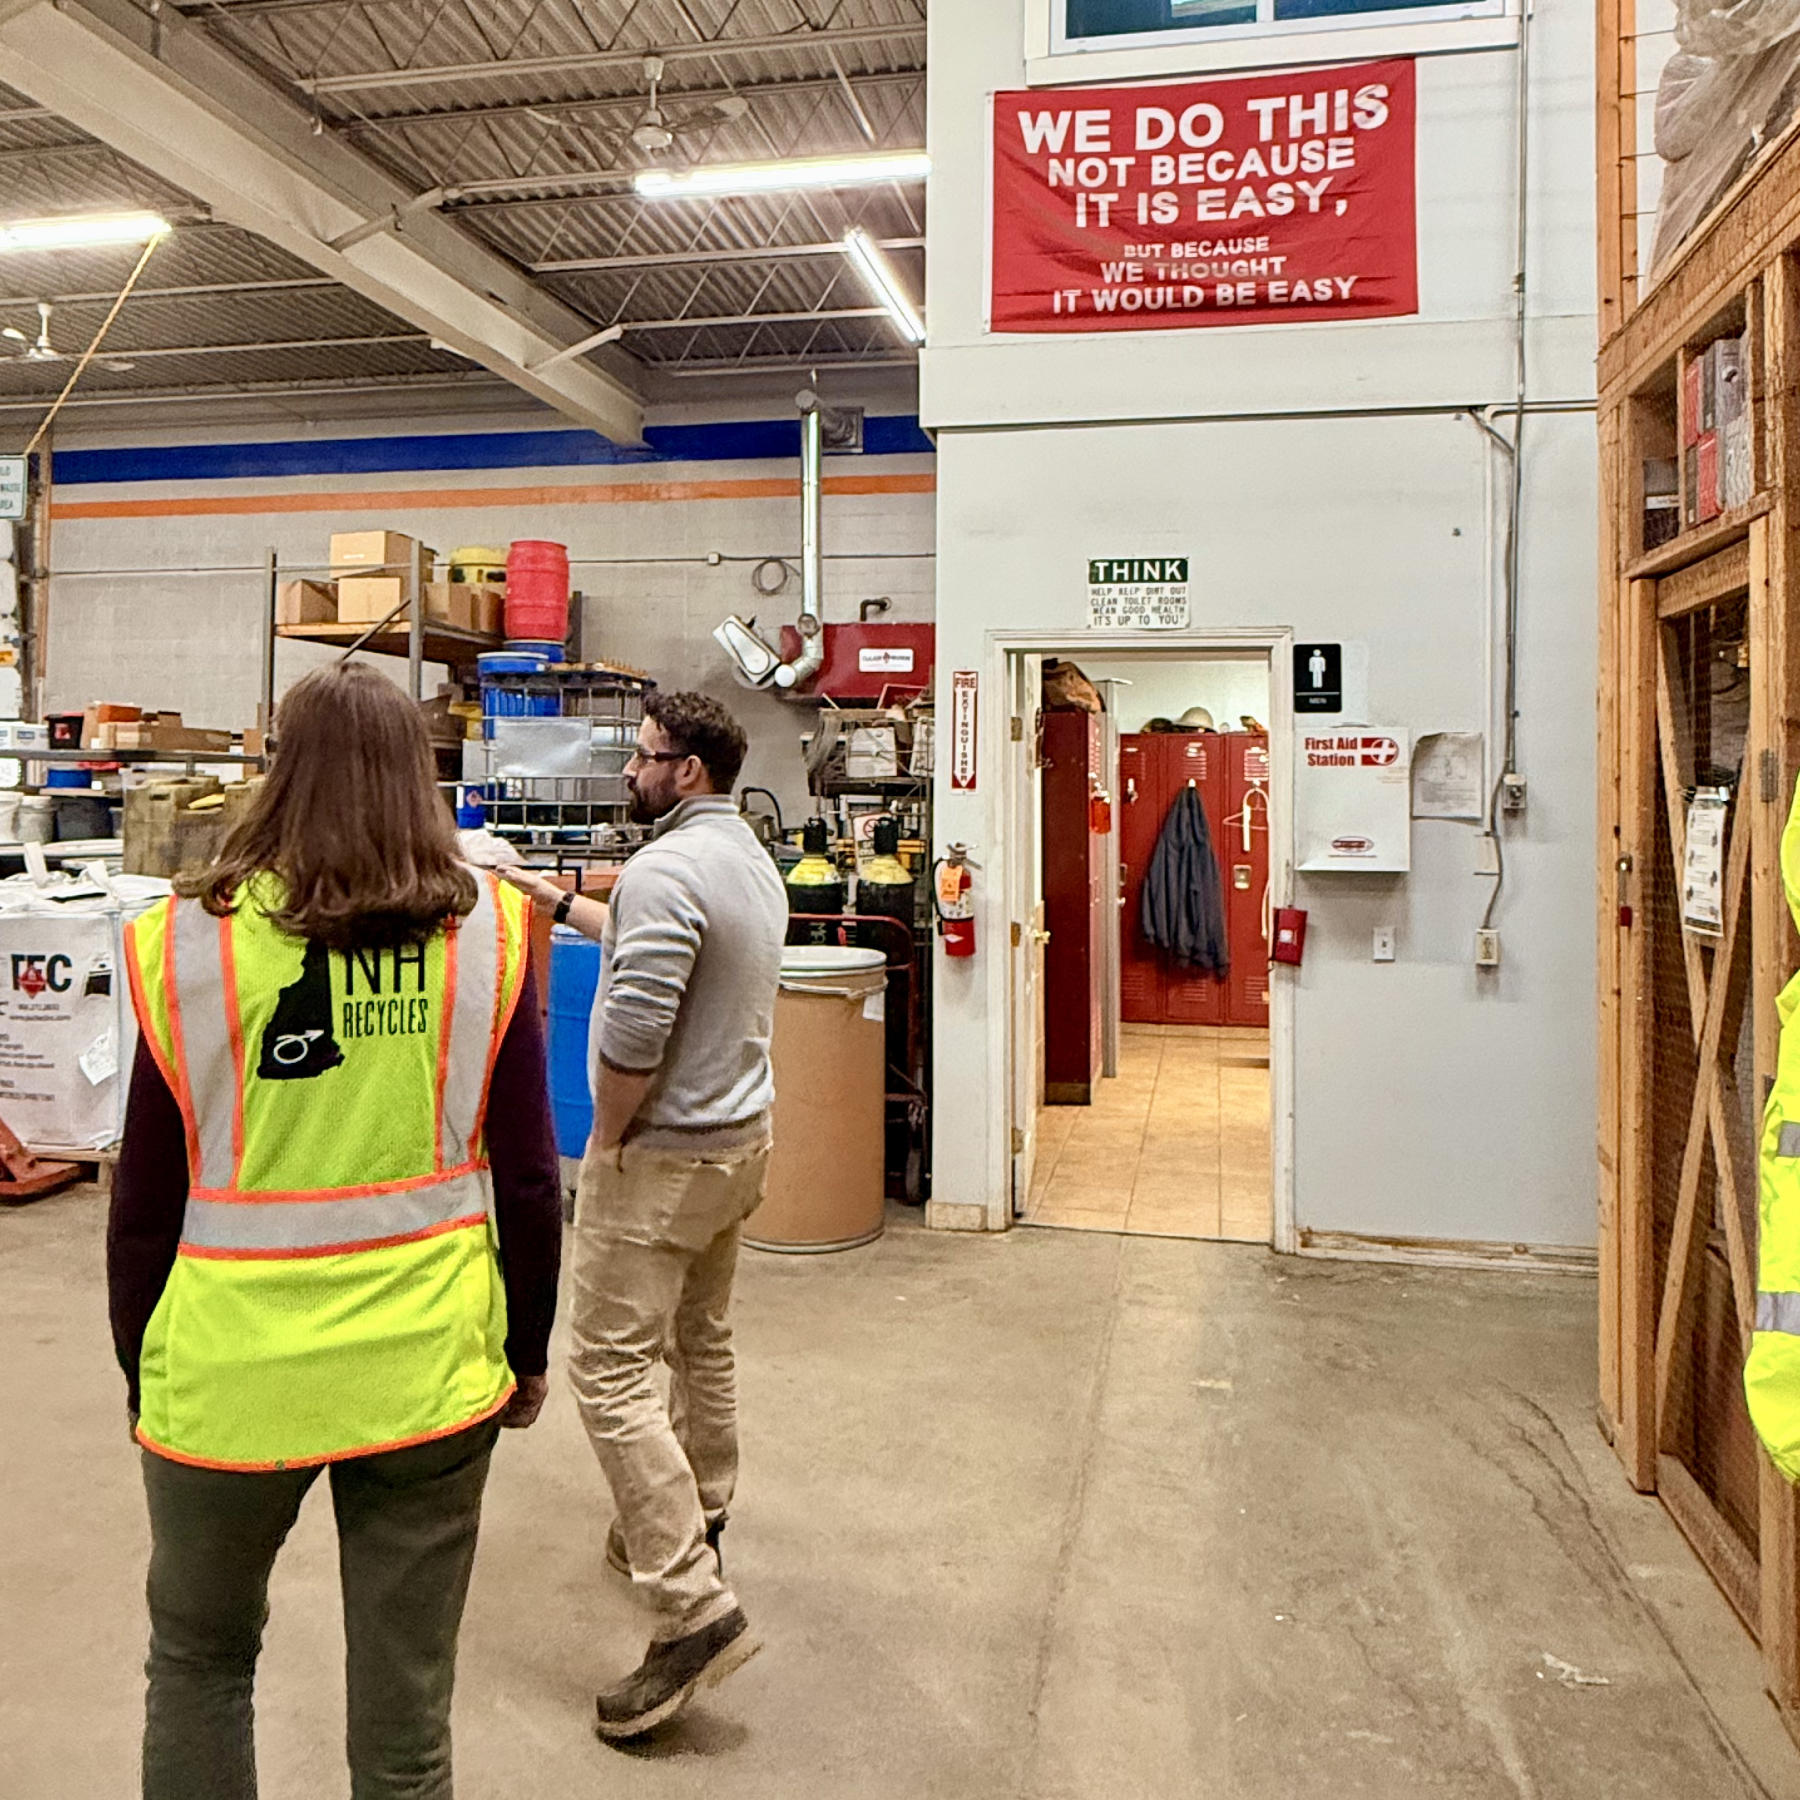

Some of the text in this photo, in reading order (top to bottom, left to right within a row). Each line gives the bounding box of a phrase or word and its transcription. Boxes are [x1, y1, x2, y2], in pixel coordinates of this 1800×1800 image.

[1018, 84, 1390, 154] WE DO THIS
[1048, 137, 1356, 188] NOT BECAUSE
[1075, 177, 1349, 228] IT IS EASY,
[1124, 236, 1270, 258] BUT BECAUSE
[1101, 256, 1287, 284] WE THOUGHT
[1053, 276, 1358, 314] IT WOULD BE EASY
[1094, 560, 1182, 581] THINK
[1090, 596, 1187, 607] CLEAN TOILET ROOMS
[1091, 586, 1187, 596] HELP KEEP DIRT OUT
[1092, 605, 1185, 615] MEAN GOOD HEALTH
[1117, 616, 1131, 626] UP
[1139, 614, 1151, 625] TO
[955, 677, 976, 689] FIRE
[960, 690, 969, 781] EXTINGUISHER
[1304, 737, 1358, 750] First Aid
[1307, 752, 1355, 766] Station
[345, 945, 426, 996] NH
[343, 999, 428, 1038] RECYCLES
